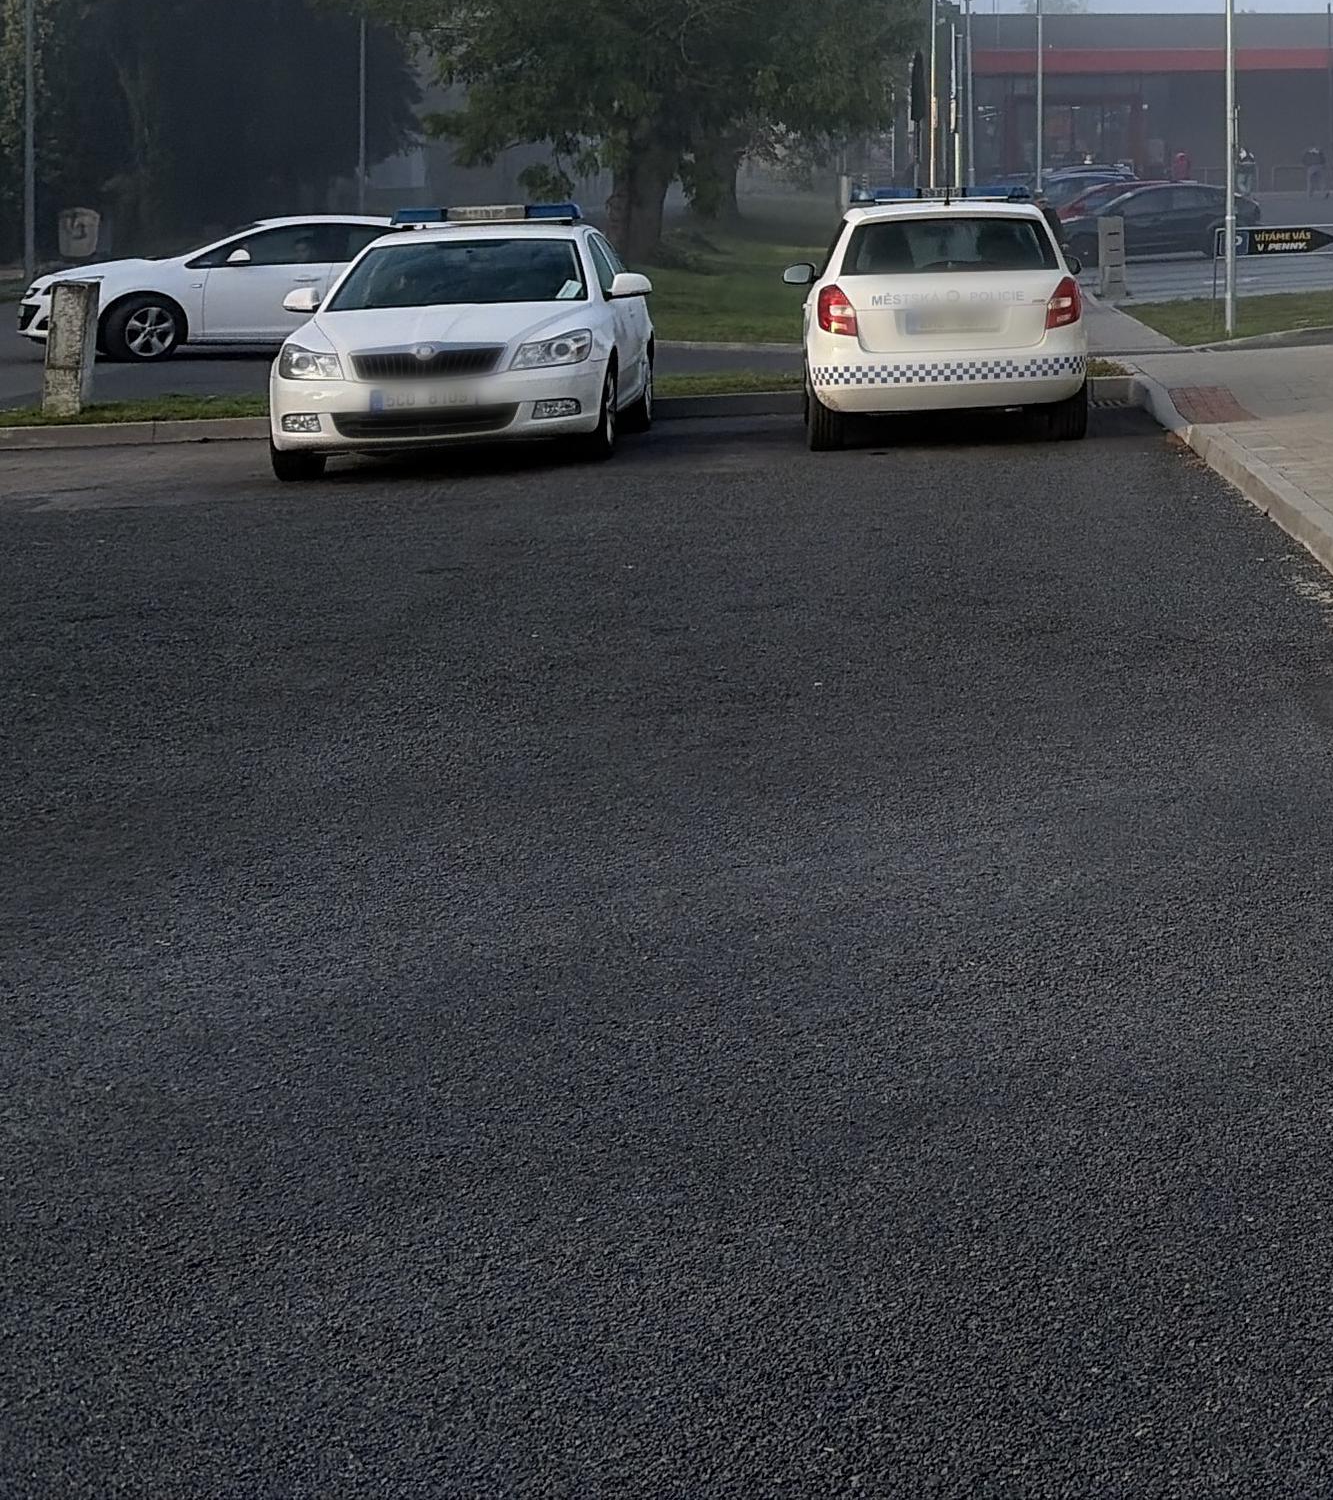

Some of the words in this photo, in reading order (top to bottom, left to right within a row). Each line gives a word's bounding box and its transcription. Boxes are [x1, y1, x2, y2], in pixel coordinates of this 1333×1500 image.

[1255, 231, 1292, 241] VÍTÁME
[1292, 231, 1311, 240] VÁS
[1257, 243, 1265, 251] V
[969, 290, 1025, 302] POLICIE
